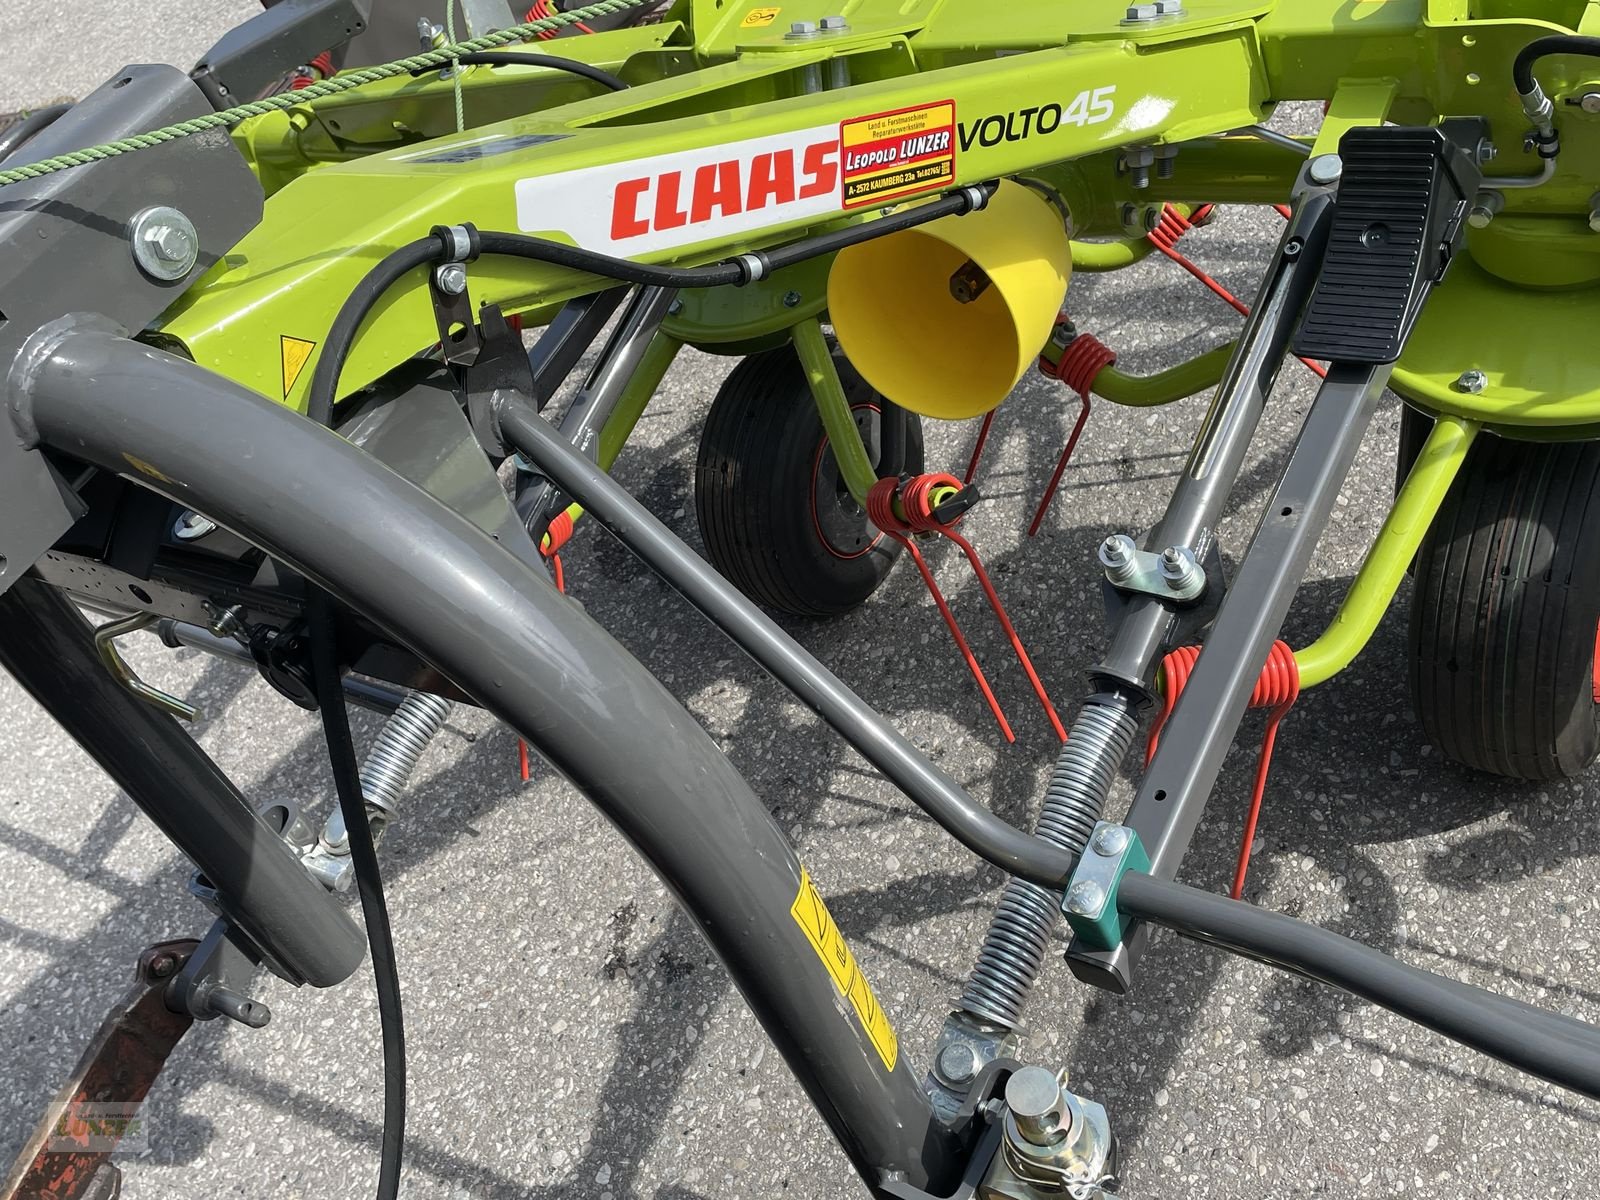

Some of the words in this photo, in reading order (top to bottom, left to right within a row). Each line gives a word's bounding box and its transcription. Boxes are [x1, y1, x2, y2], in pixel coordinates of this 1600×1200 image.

[868, 121, 880, 130] Land
[888, 113, 927, 126] Forstmaschinen
[846, 147, 897, 171] LEOPOLD
[900, 131, 951, 159] LUNZER
[611, 139, 840, 241] CLAAS
[870, 174, 904, 189] KAUMBERG
